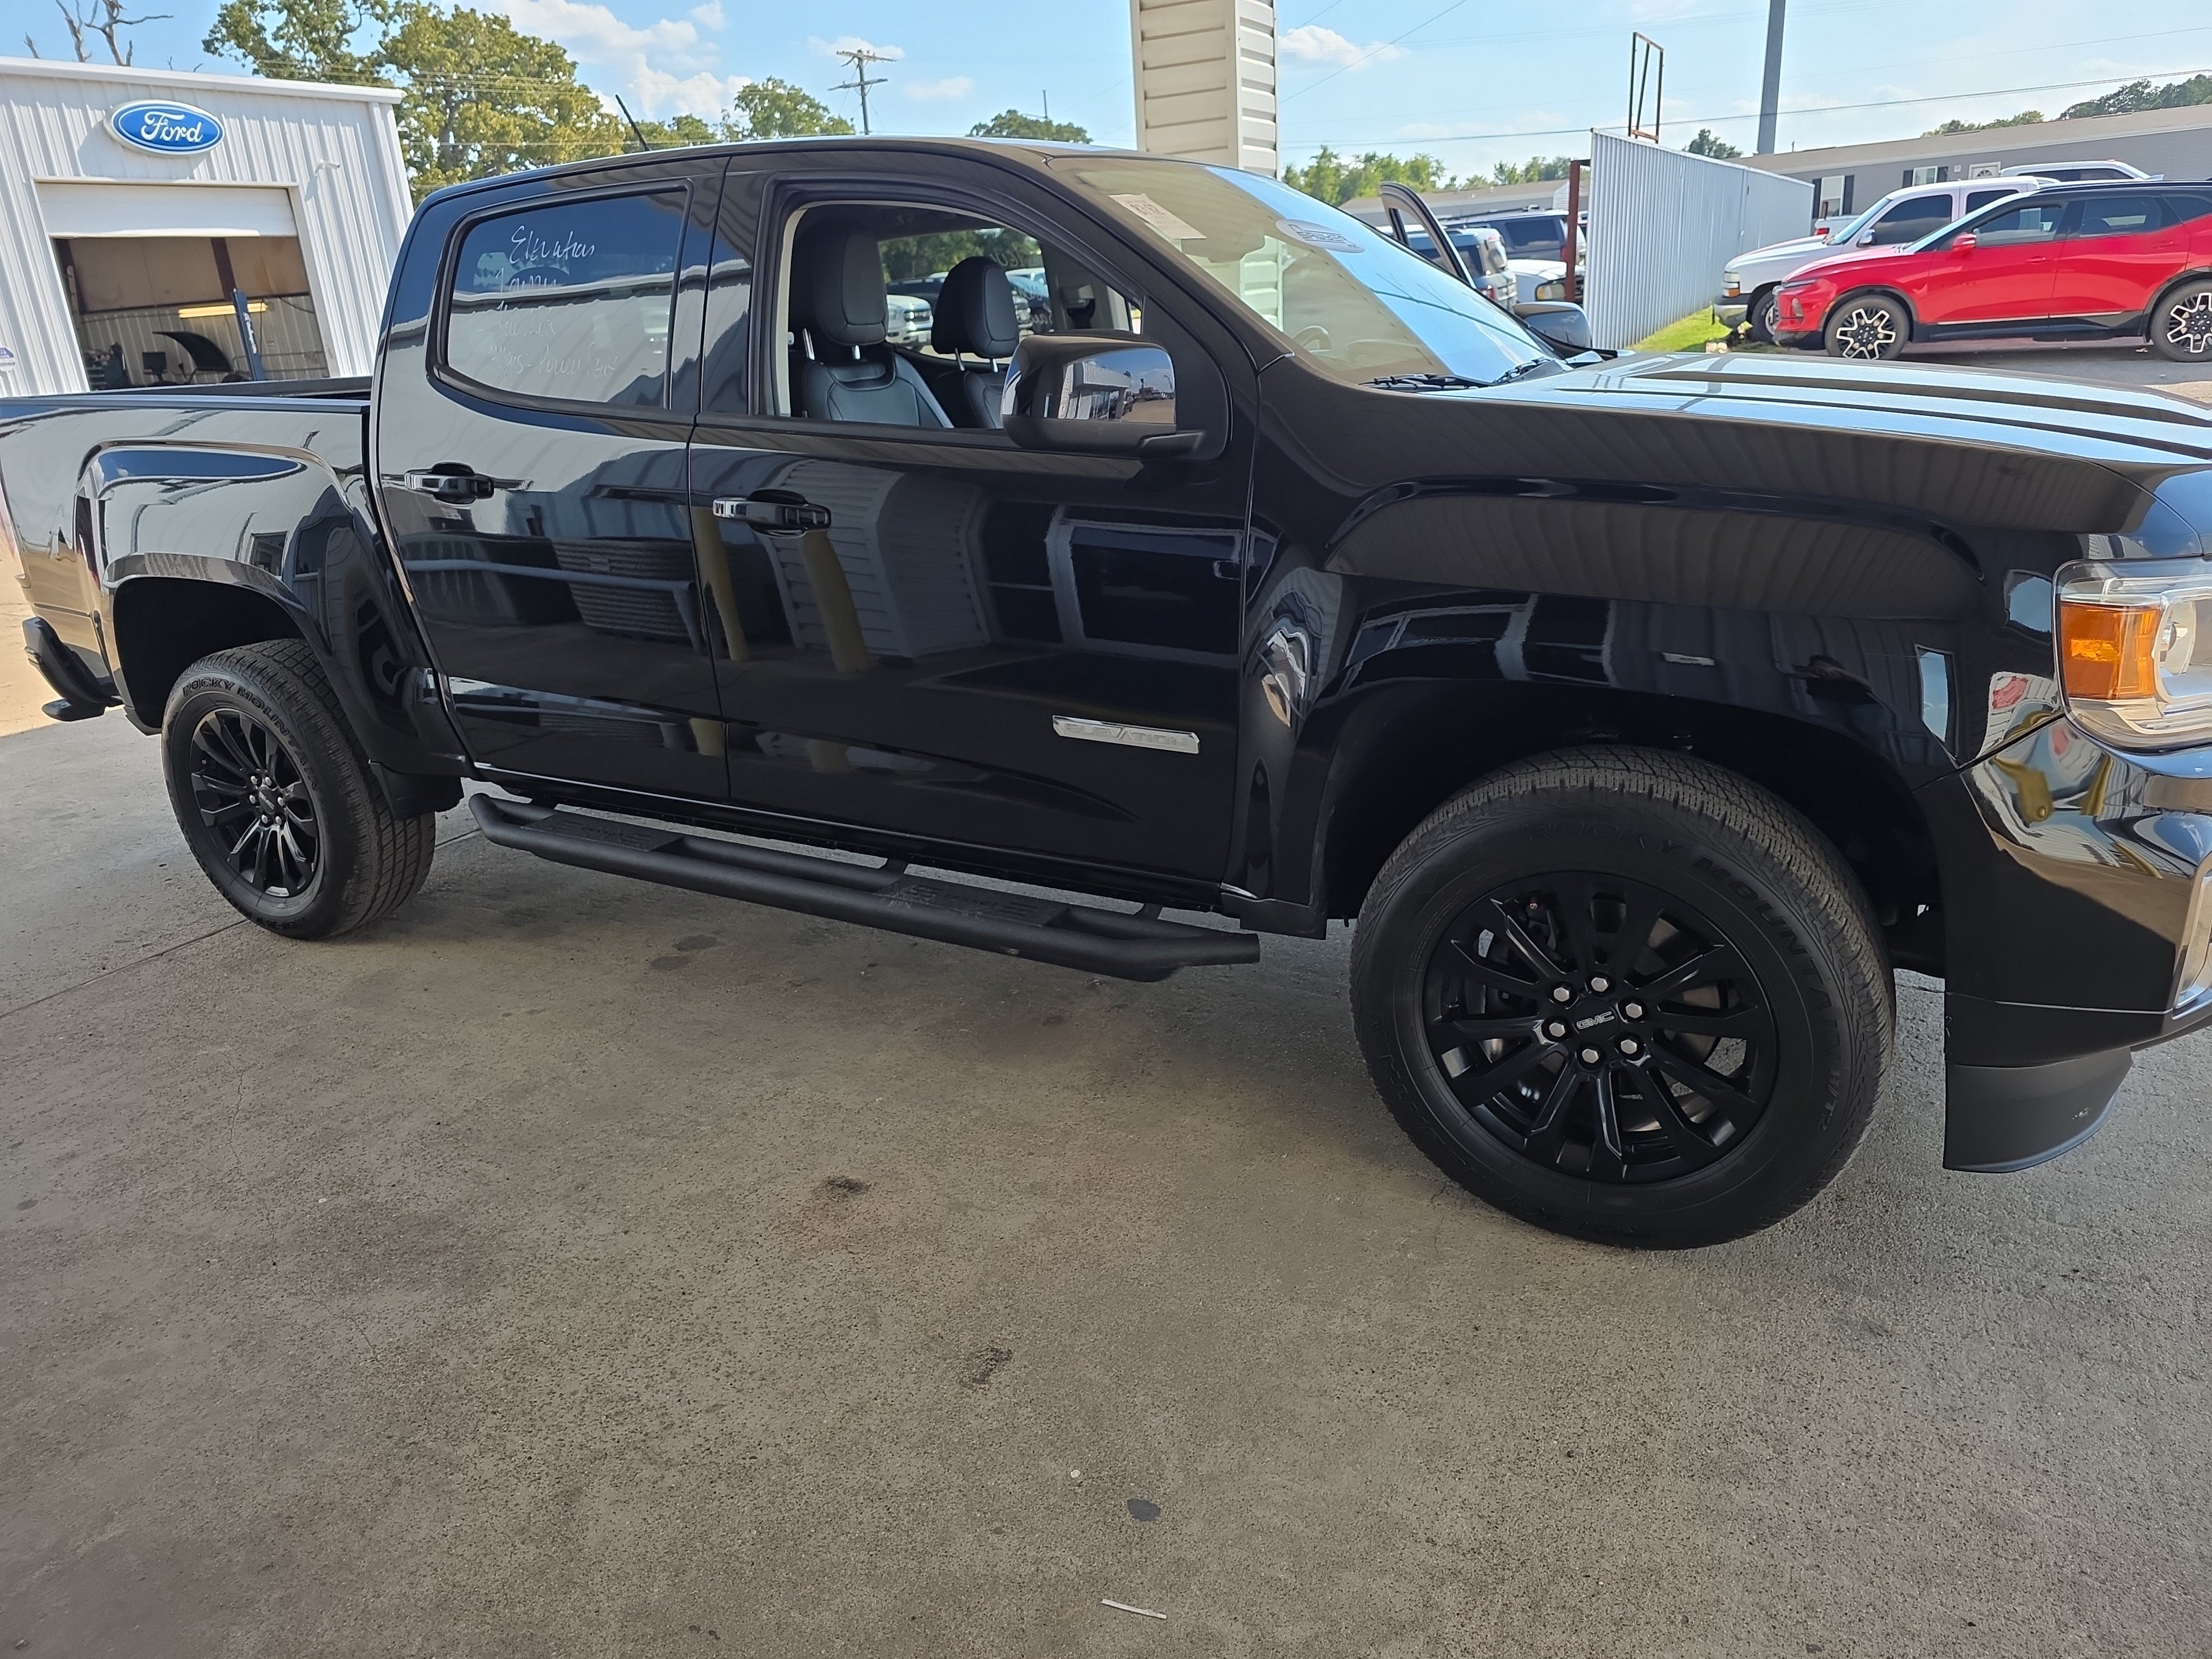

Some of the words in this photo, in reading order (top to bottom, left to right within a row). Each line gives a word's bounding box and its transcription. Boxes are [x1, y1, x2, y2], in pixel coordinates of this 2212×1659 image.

[140, 111, 203, 143] Ford
[182, 677, 235, 697] ROCKY
[237, 686, 320, 789] MOUNTAIN
[1064, 723, 1189, 747] ELEVATION
[1576, 1011, 1615, 1030] GMC
